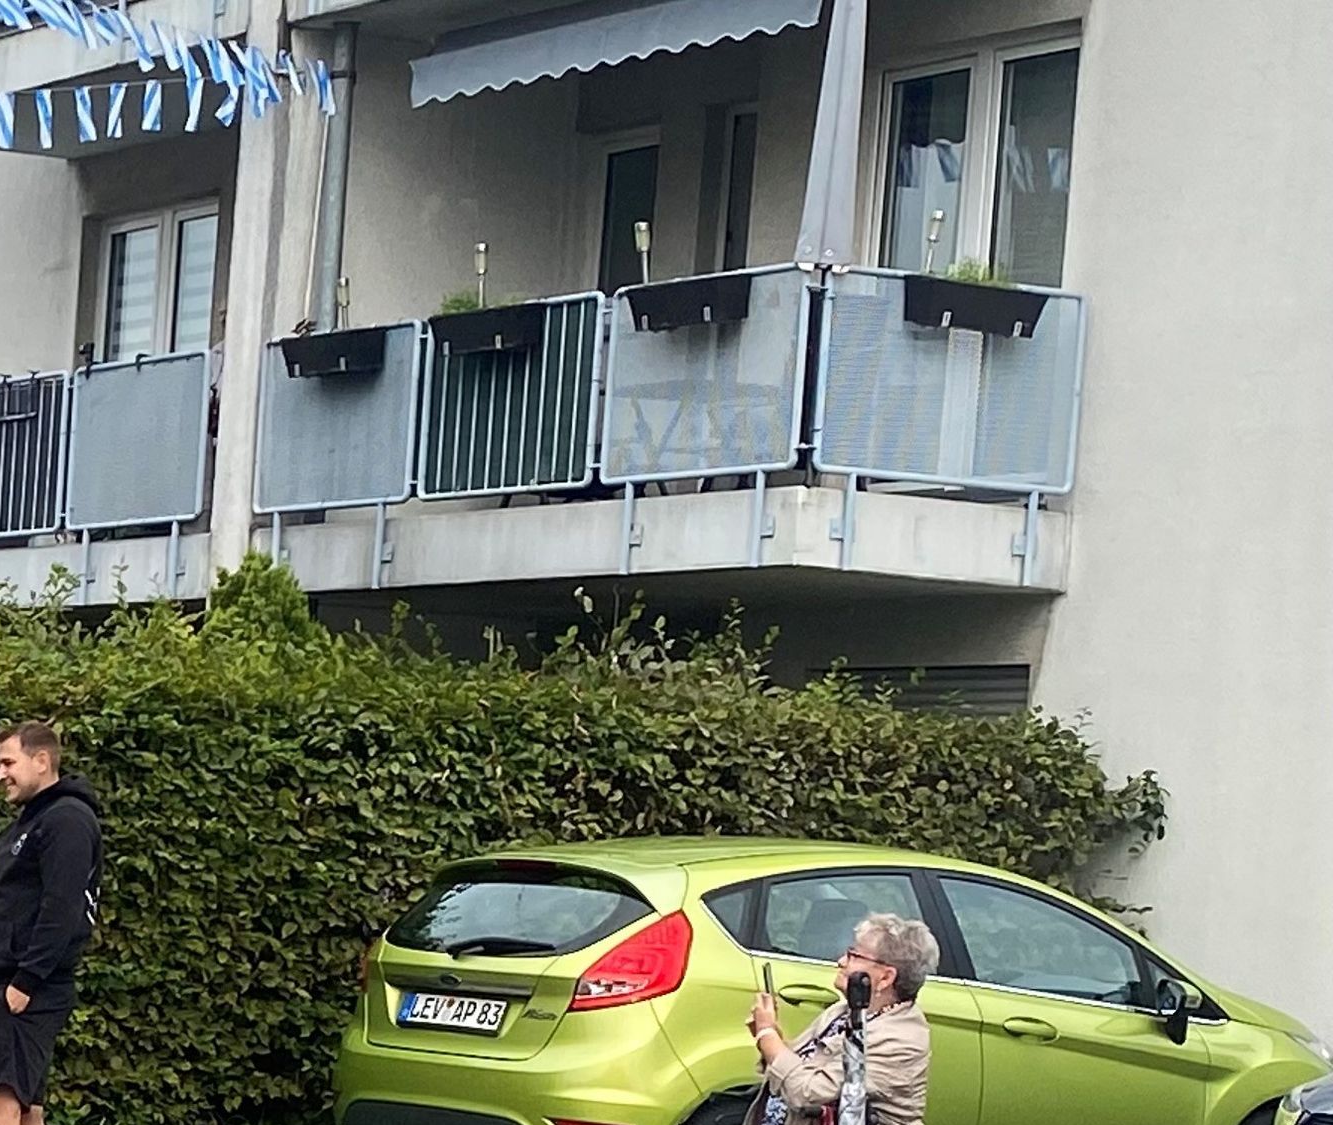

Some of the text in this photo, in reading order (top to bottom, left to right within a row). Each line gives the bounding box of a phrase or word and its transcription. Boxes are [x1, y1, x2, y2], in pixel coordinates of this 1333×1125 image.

[409, 995, 446, 1020] LEV
[451, 999, 478, 1023] AP
[476, 1001, 504, 1027] 83
